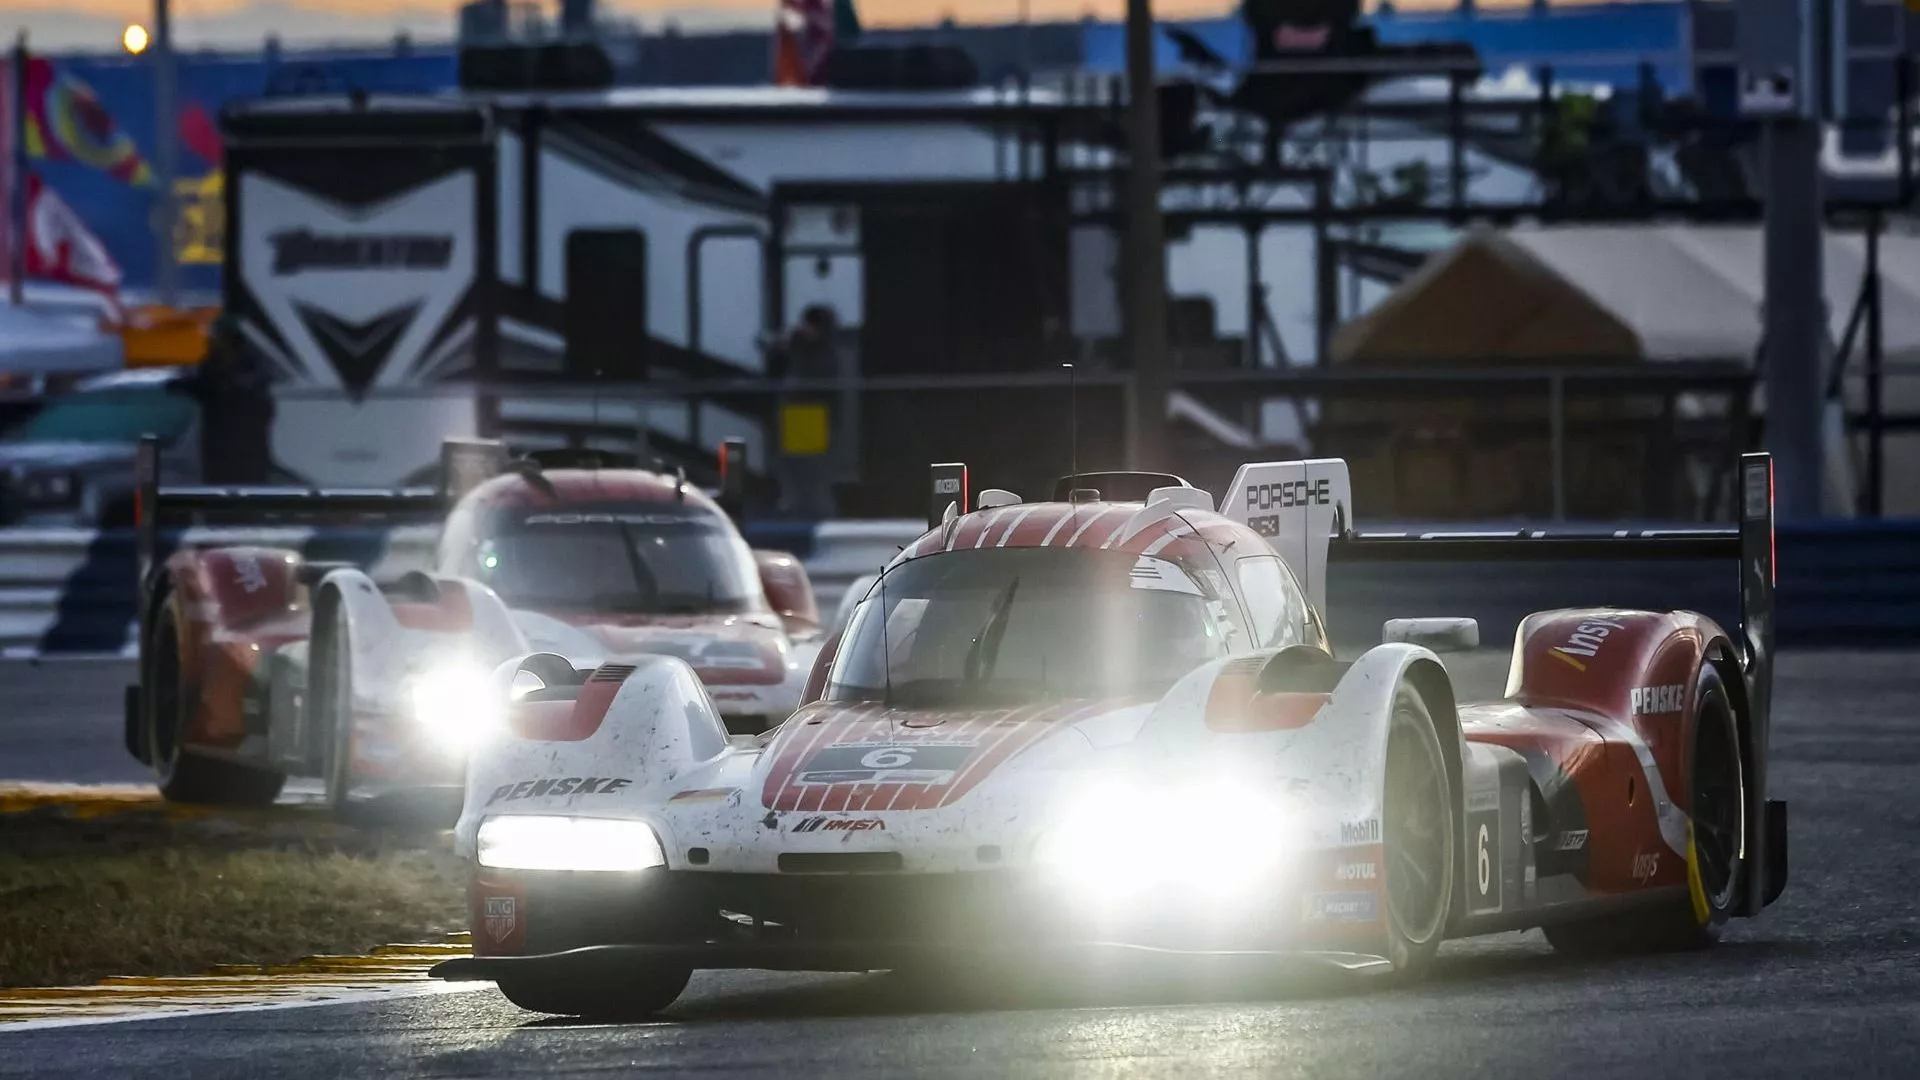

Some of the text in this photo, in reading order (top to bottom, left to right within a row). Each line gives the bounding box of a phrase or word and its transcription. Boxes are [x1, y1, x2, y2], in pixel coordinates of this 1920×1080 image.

[1247, 479, 1330, 511] PORSCHE
[1630, 684, 1685, 716] PENSKE
[860, 747, 918, 769] 6
[485, 777, 633, 807] PENSKE
[822, 819, 886, 831] IMSA
[1336, 862, 1377, 879] MOTUL
[1477, 823, 1490, 895] 6
